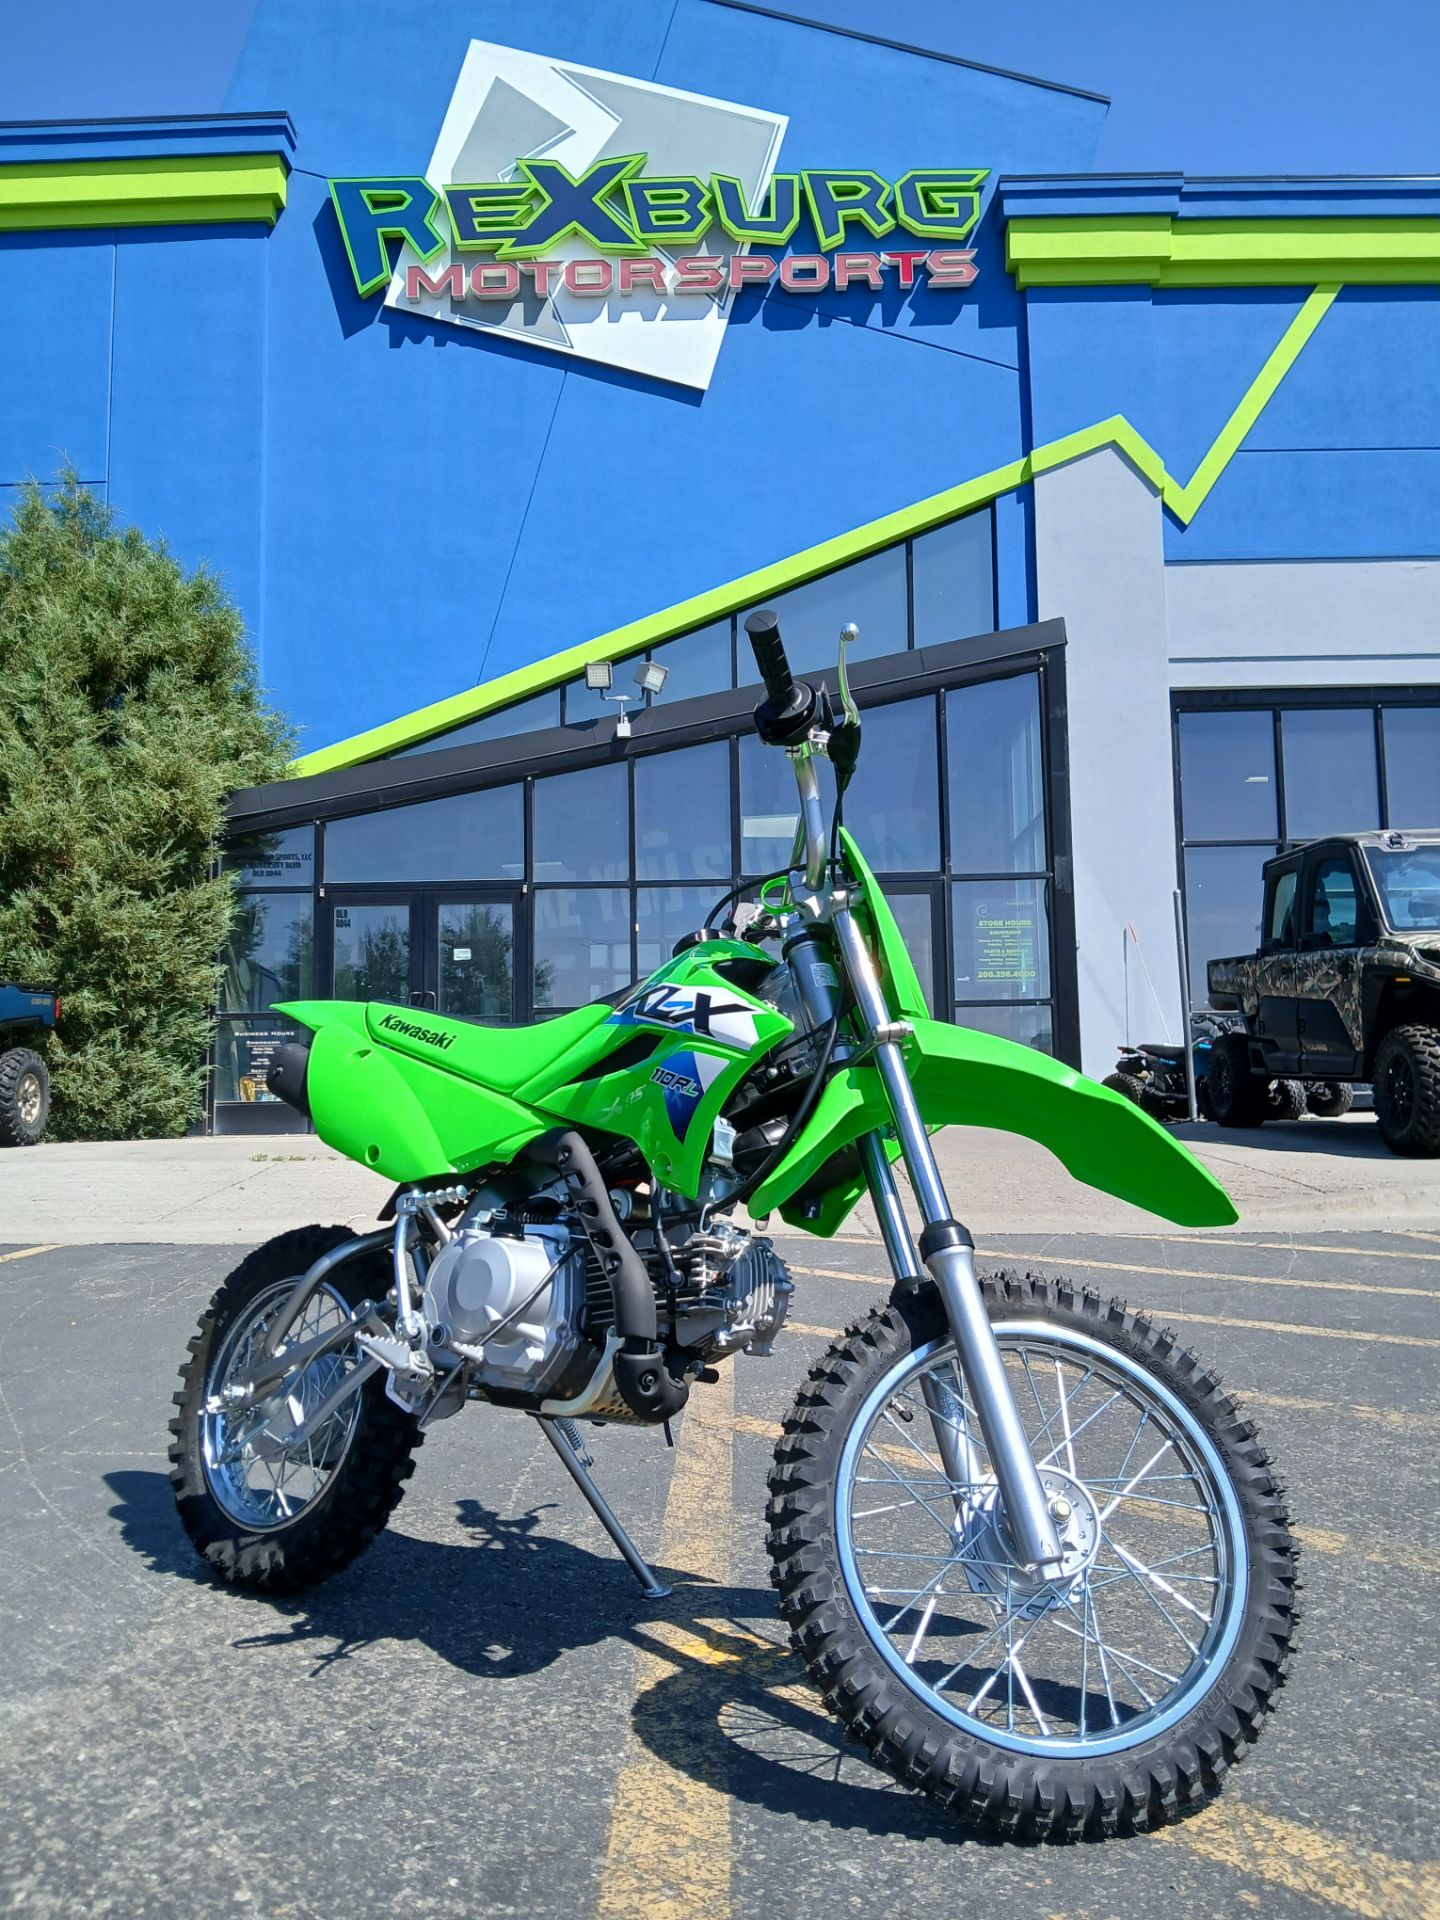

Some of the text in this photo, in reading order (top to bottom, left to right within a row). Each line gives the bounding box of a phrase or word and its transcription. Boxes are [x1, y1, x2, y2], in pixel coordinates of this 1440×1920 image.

[327, 152, 992, 300] REXBURG
[405, 248, 979, 303] MOTORSPORTS
[378, 1013, 458, 1050] Kawasaki
[650, 1066, 699, 1097] 110RL
